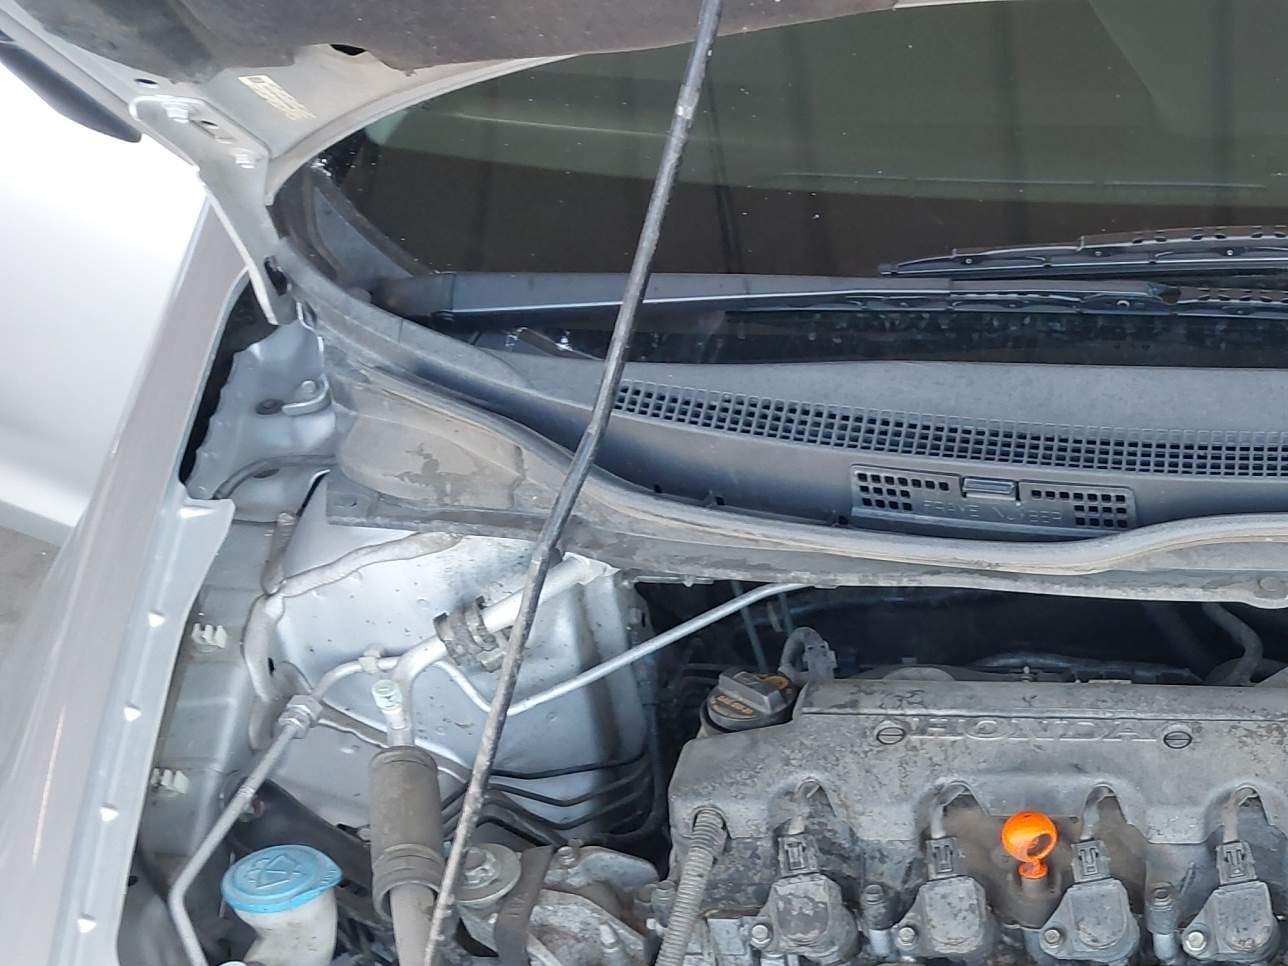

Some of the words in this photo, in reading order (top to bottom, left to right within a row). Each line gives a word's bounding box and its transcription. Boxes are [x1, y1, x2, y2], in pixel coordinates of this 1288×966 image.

[923, 499, 981, 518] FRAME
[991, 504, 1063, 522] NUMBER
[910, 717, 1157, 742] HONDA
